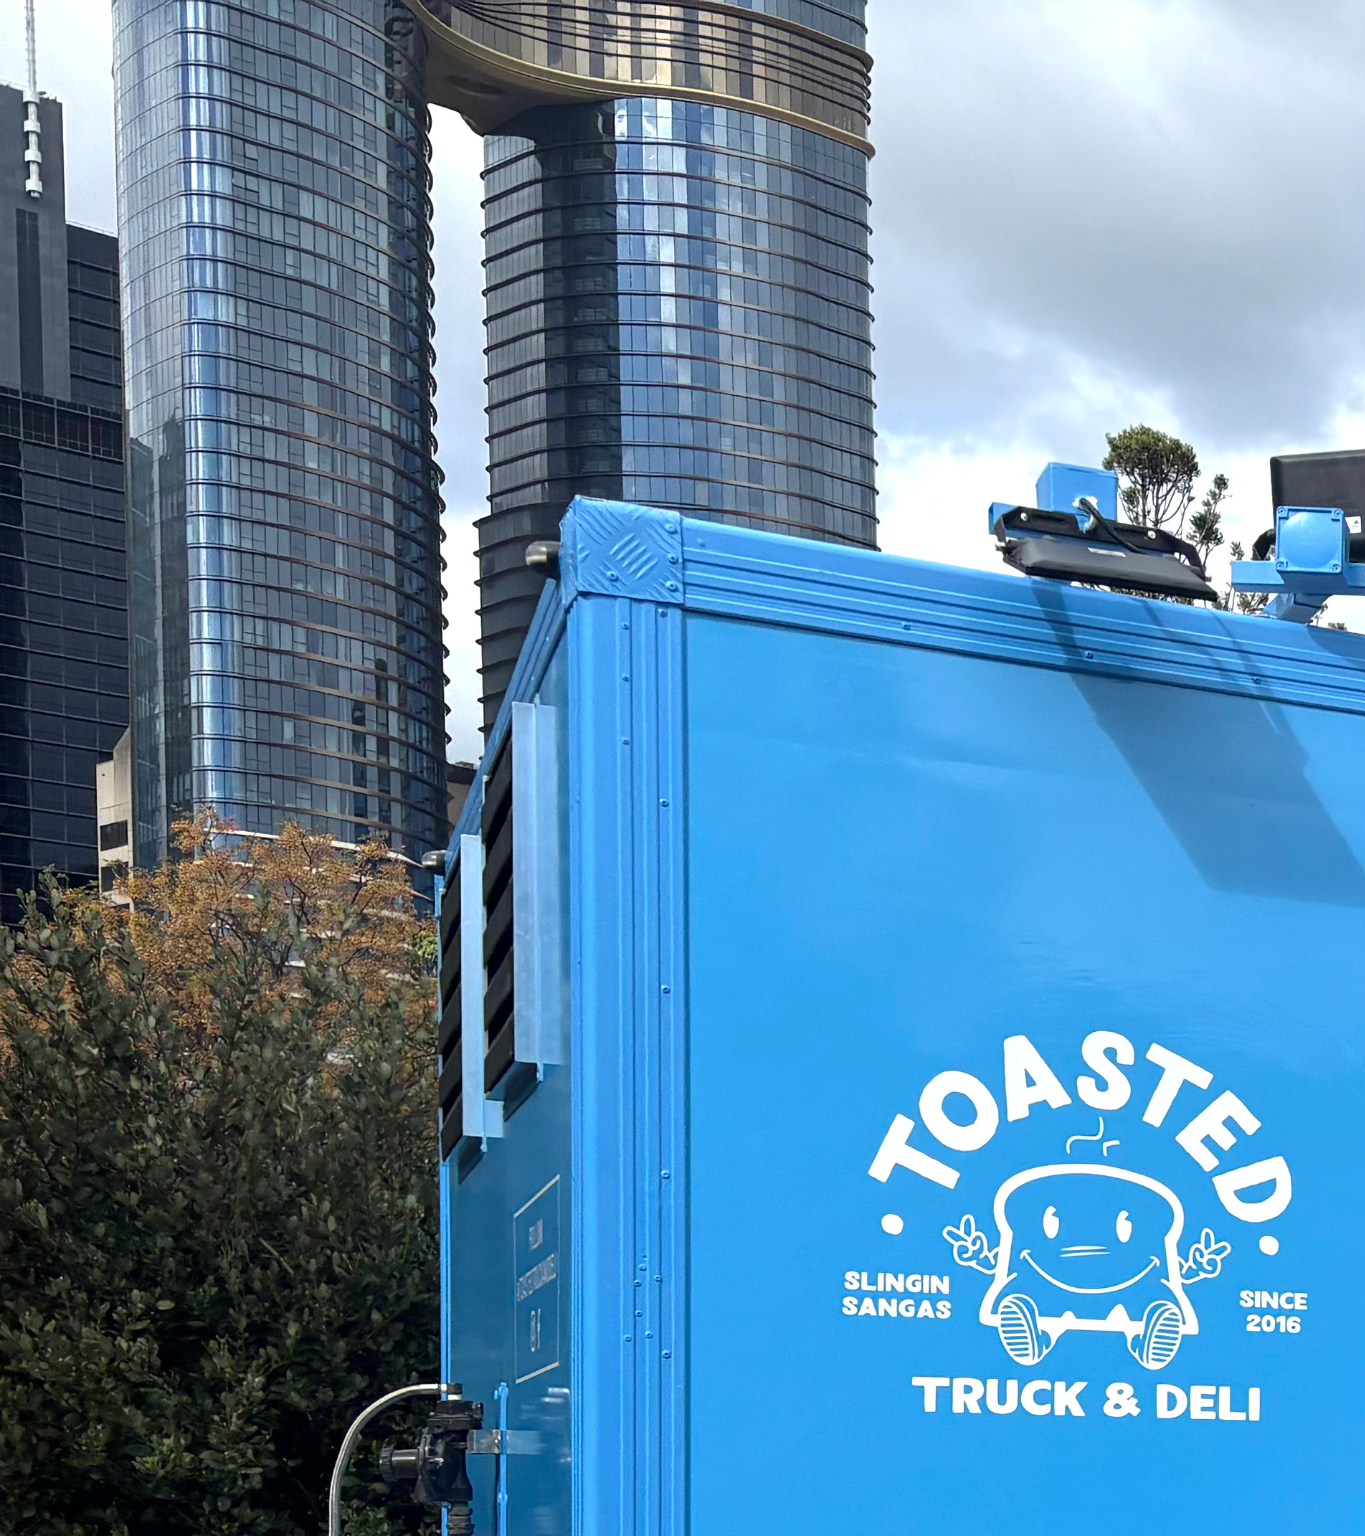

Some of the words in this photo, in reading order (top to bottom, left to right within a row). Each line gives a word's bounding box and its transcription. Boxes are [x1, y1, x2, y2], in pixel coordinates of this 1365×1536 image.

[868, 1031, 1291, 1222] TOASTED
[844, 1271, 949, 1294] SLINGIN
[842, 1297, 951, 1318] SANGAS
[1240, 1290, 1307, 1310] SINCE
[1247, 1315, 1300, 1333] 2016
[912, 1377, 1087, 1416] TRUCK
[1103, 1383, 1140, 1417] &
[1157, 1384, 1260, 1421] DELI
